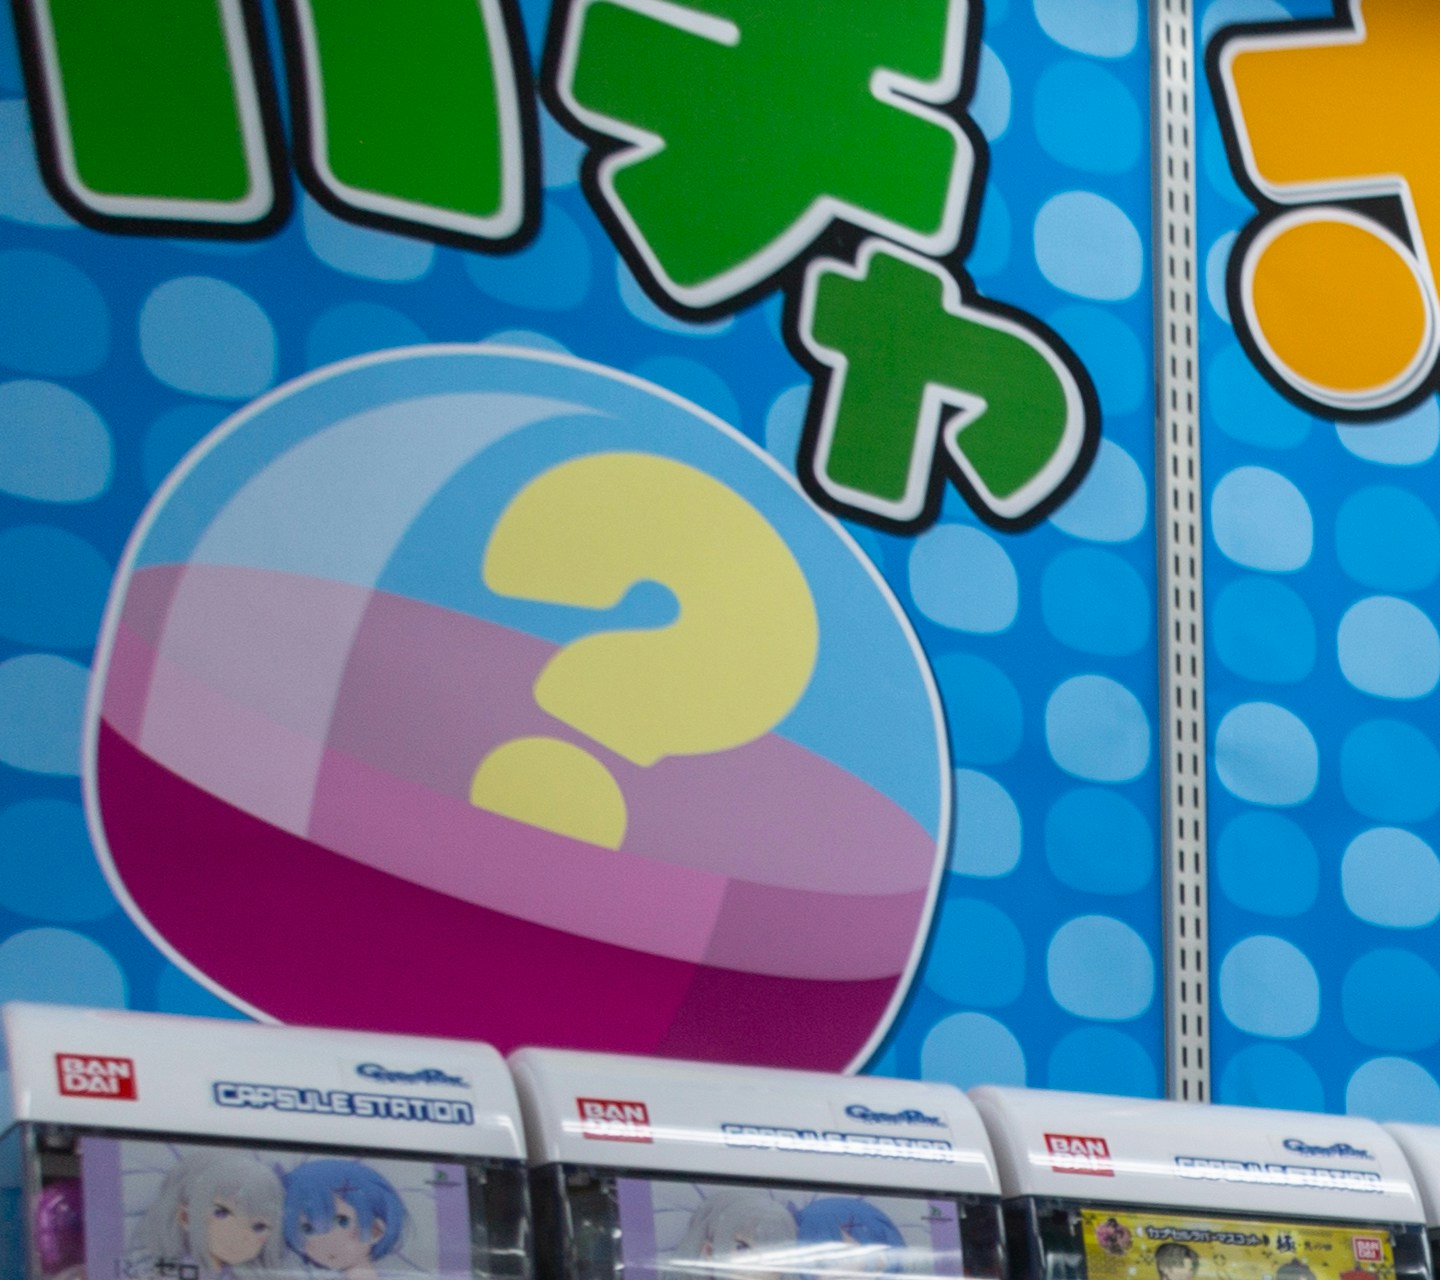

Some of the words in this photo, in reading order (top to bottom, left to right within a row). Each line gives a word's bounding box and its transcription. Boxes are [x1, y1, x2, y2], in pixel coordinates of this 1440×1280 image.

[63, 1059, 128, 1077] BAN
[65, 1076, 118, 1093] DAI
[214, 1082, 349, 1115] CAPSULE
[355, 1092, 475, 1125] STATION
[582, 1101, 644, 1122] BAN
[1049, 1137, 1108, 1155] BAN
